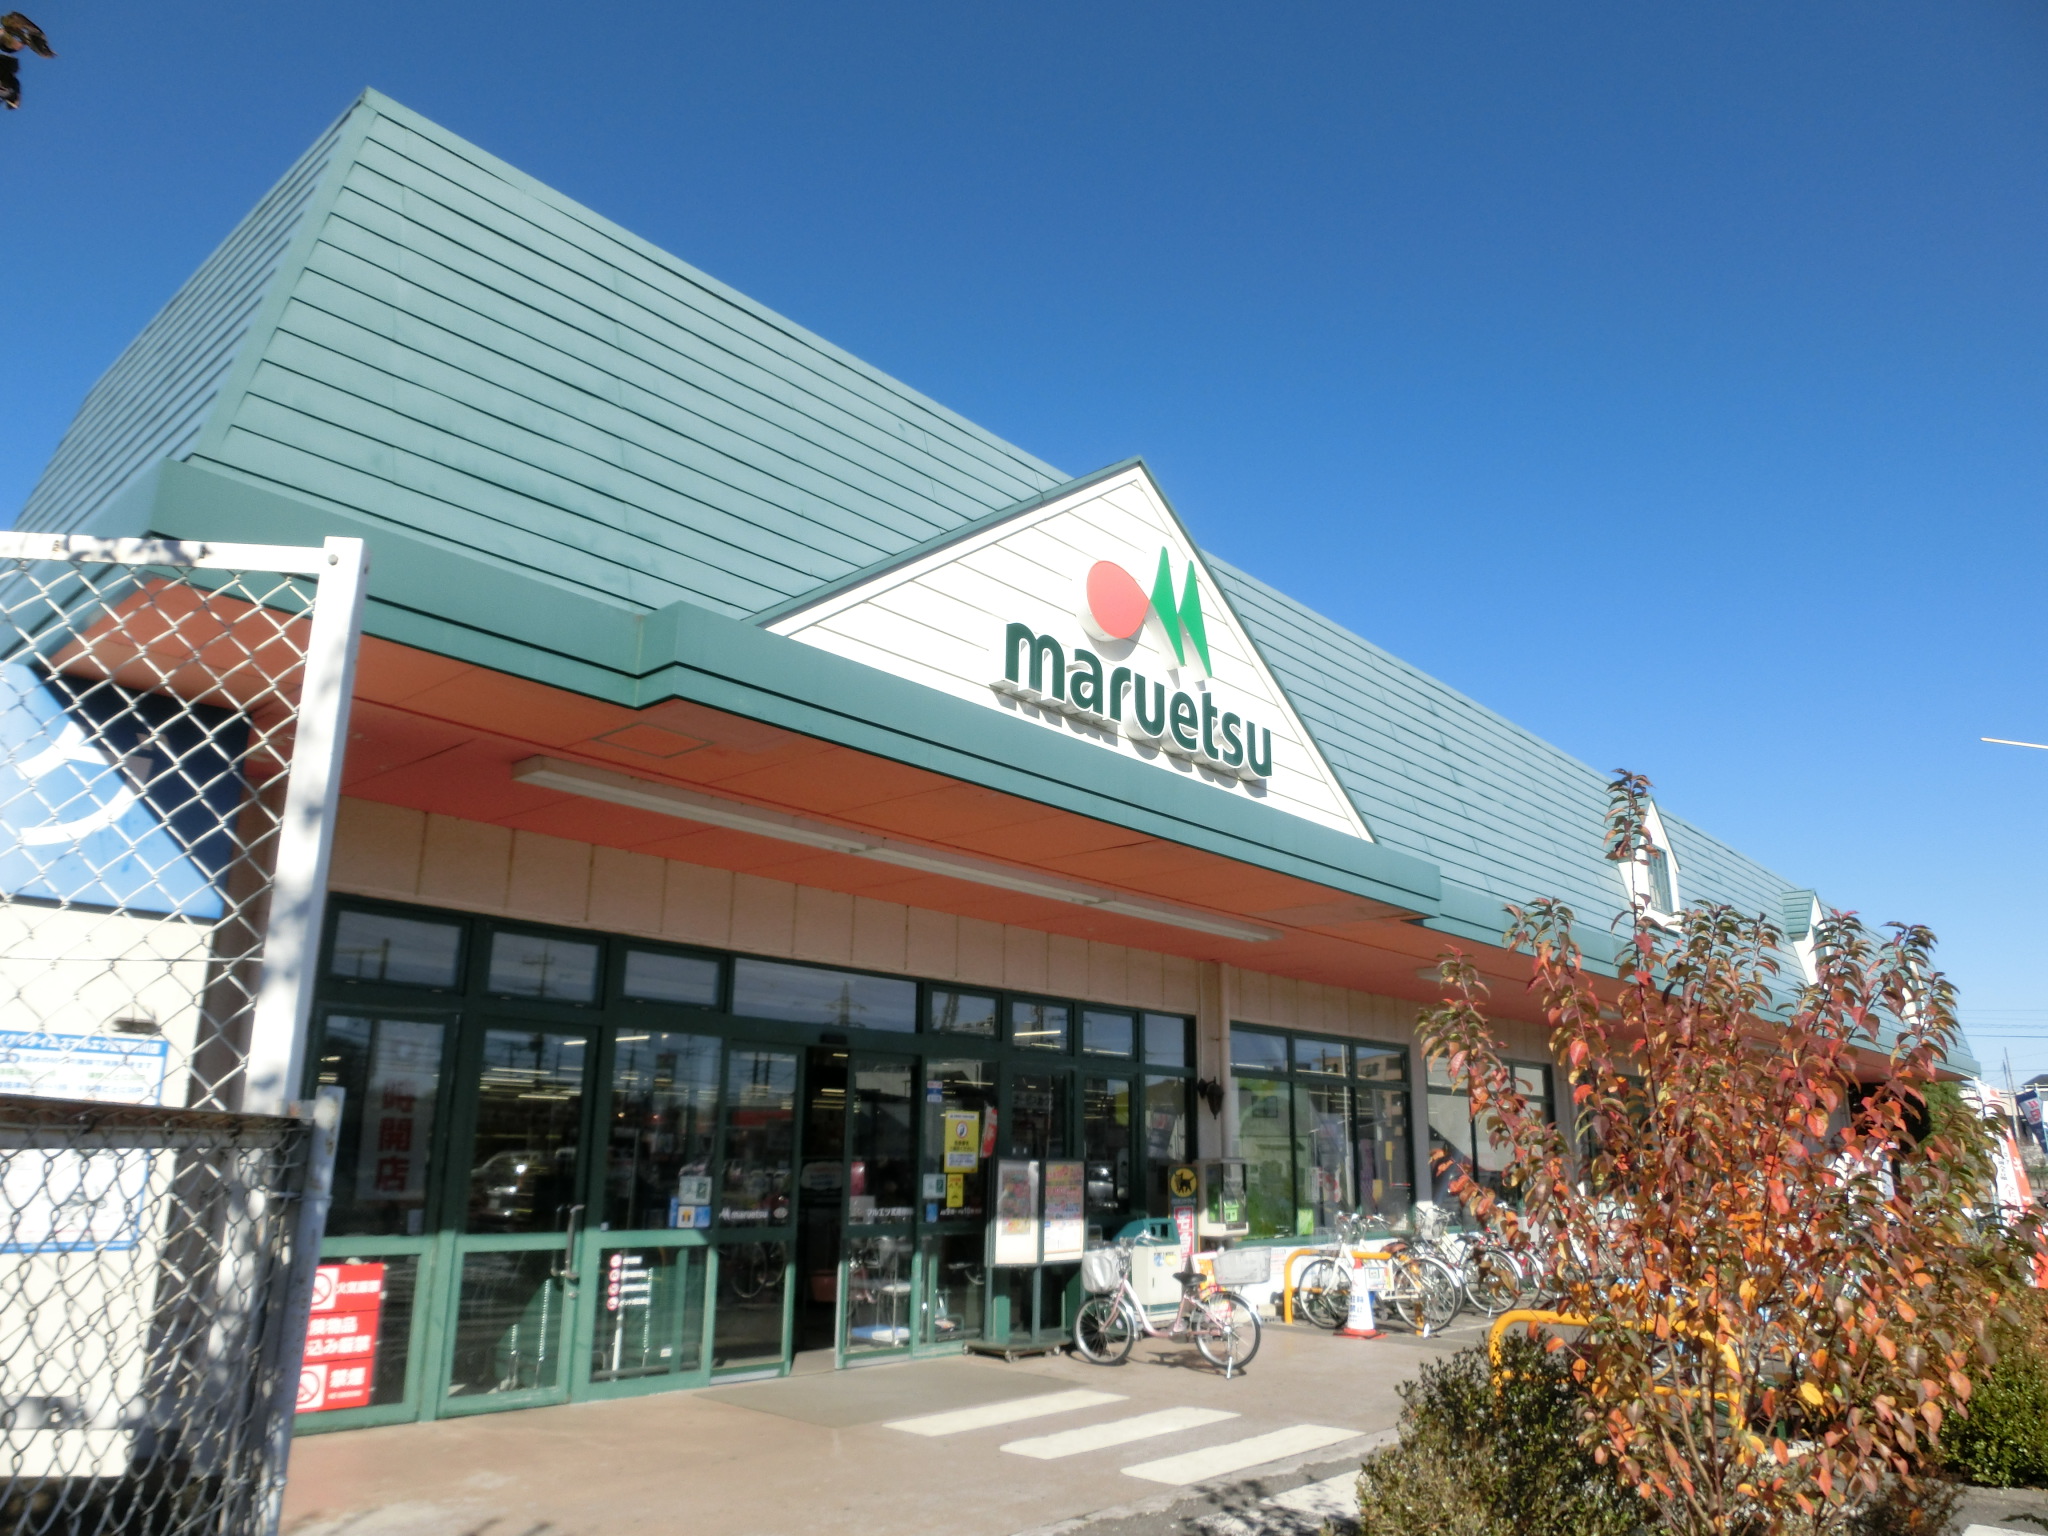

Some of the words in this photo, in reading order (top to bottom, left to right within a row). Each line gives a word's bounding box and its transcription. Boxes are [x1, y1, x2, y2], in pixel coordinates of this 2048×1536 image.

[1004, 621, 1273, 778] maruetsu
[305, 1335, 371, 1357] 込み厳禁
